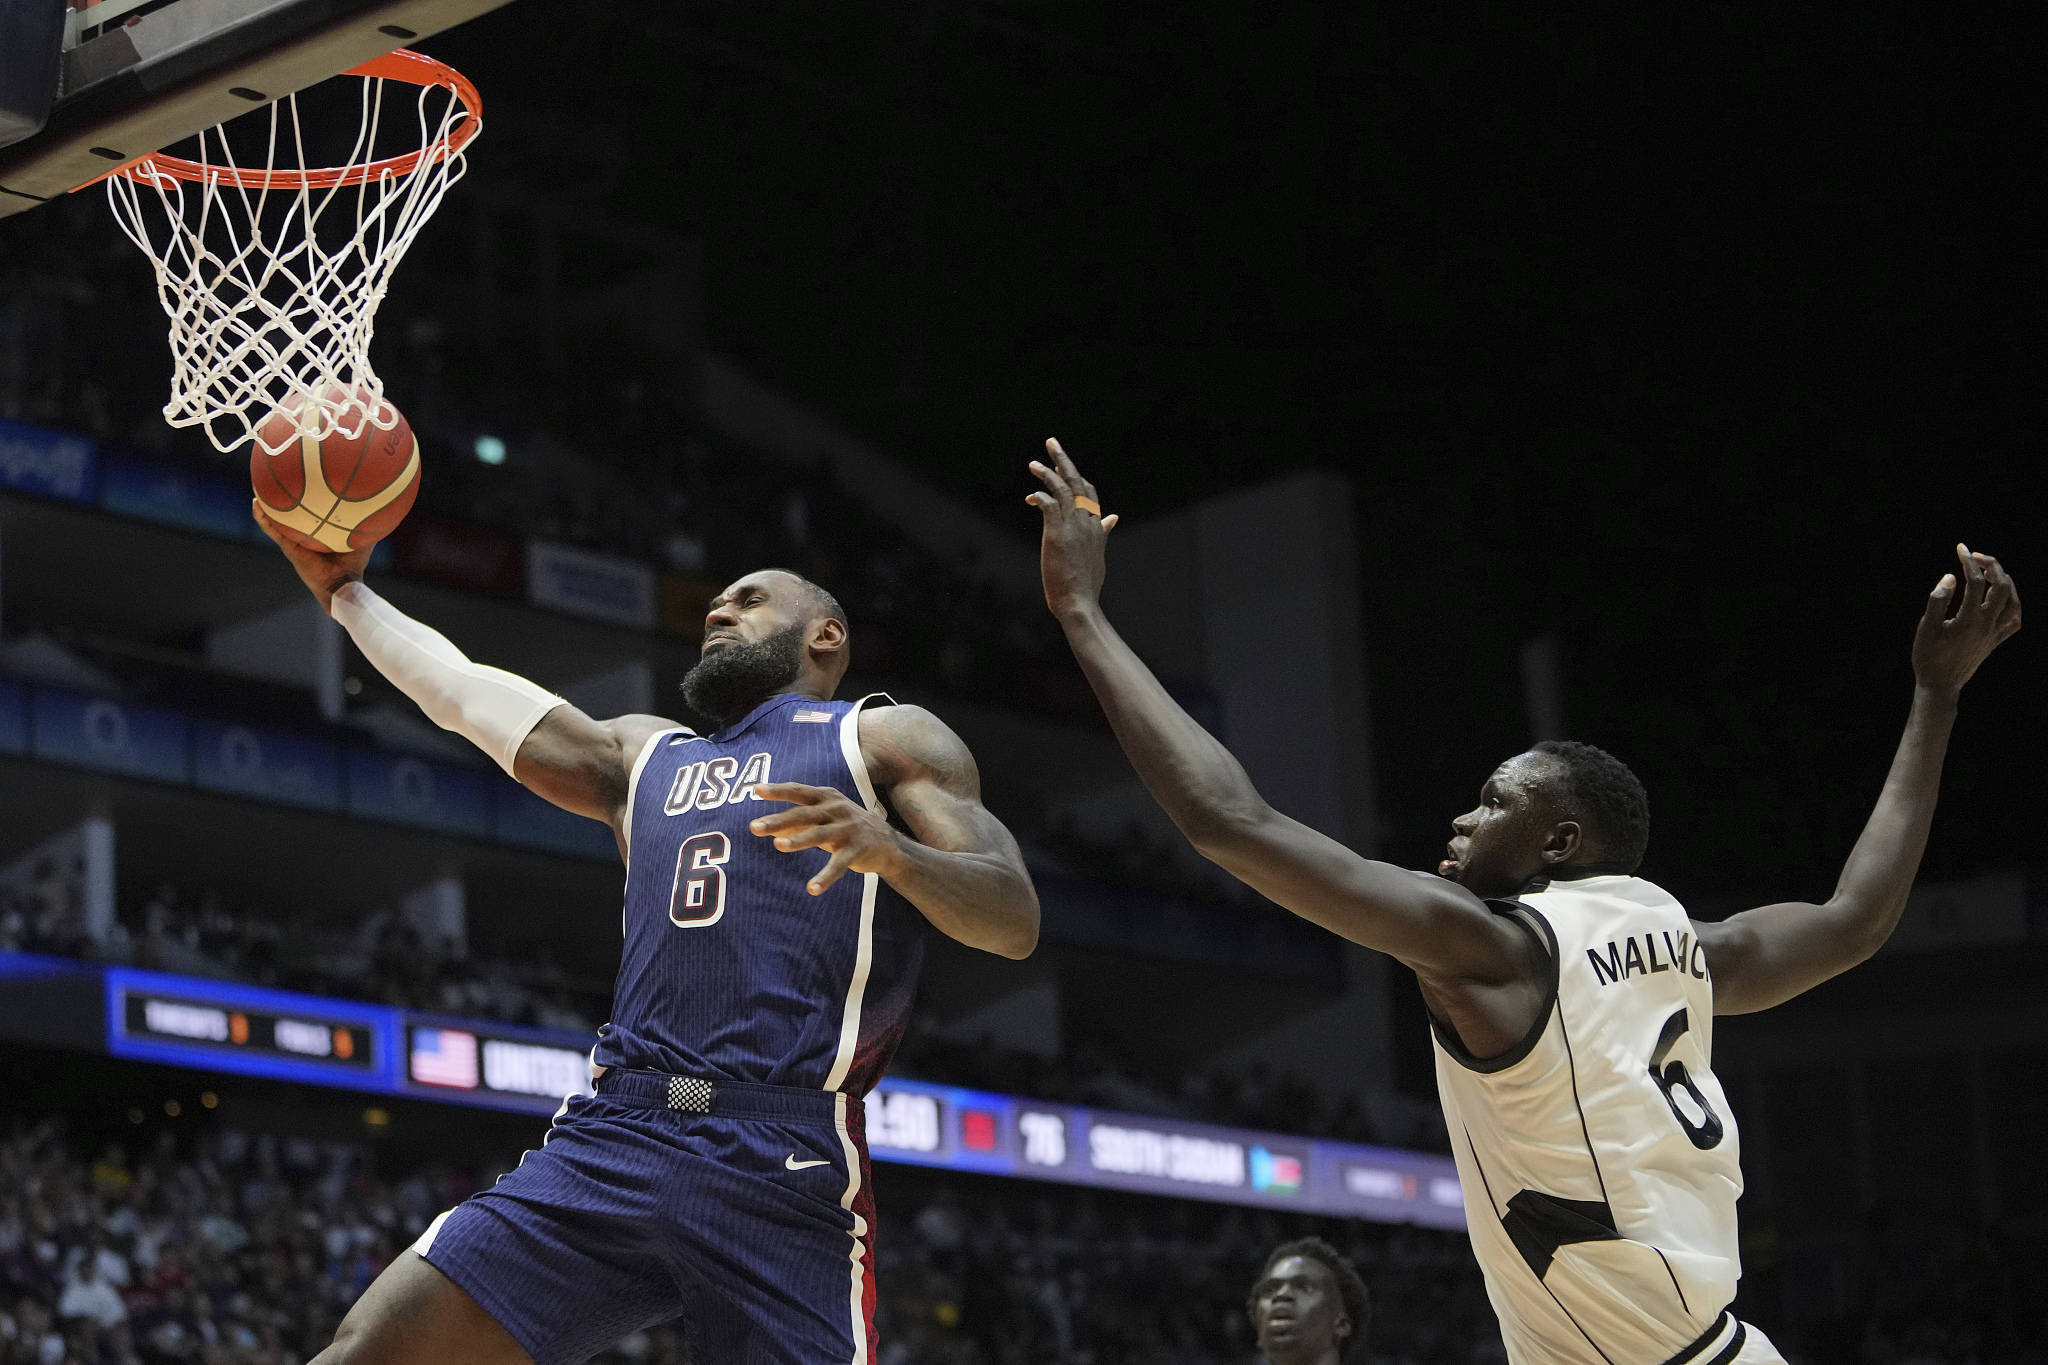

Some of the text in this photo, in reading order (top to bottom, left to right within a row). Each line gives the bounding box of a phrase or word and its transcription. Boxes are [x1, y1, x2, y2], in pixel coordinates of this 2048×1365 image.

[664, 752, 771, 816] USA
[669, 831, 731, 928] 6
[1586, 930, 1710, 986] MALAC
[1648, 1007, 1723, 1150] 6
